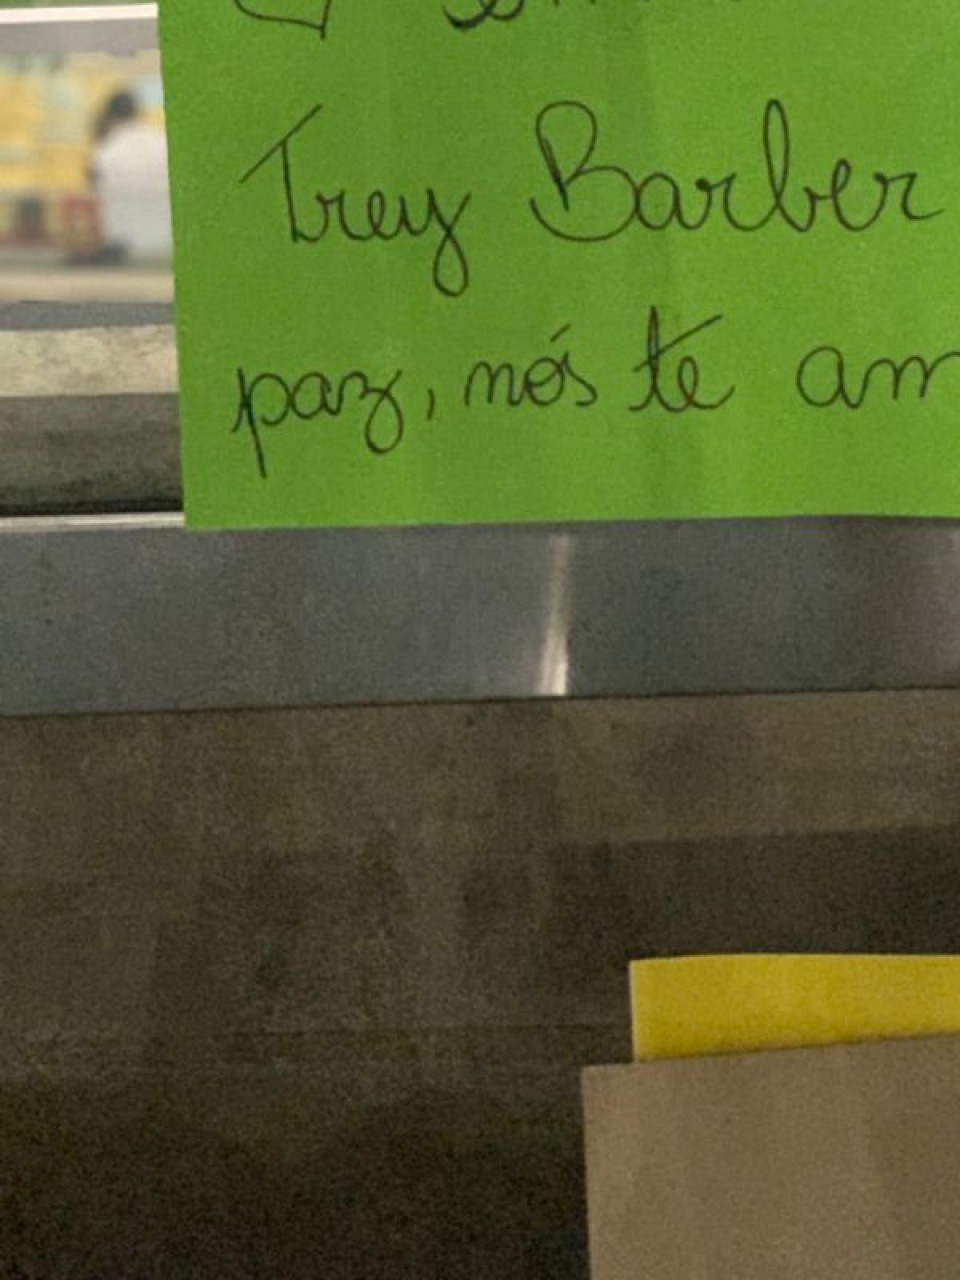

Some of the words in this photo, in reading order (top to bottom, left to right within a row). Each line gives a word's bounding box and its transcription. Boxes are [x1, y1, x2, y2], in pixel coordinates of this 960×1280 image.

[239, 104, 471, 298] Trey
[231, 367, 436, 479] paz,
[463, 324, 598, 408] nós
[628, 305, 736, 414] te
